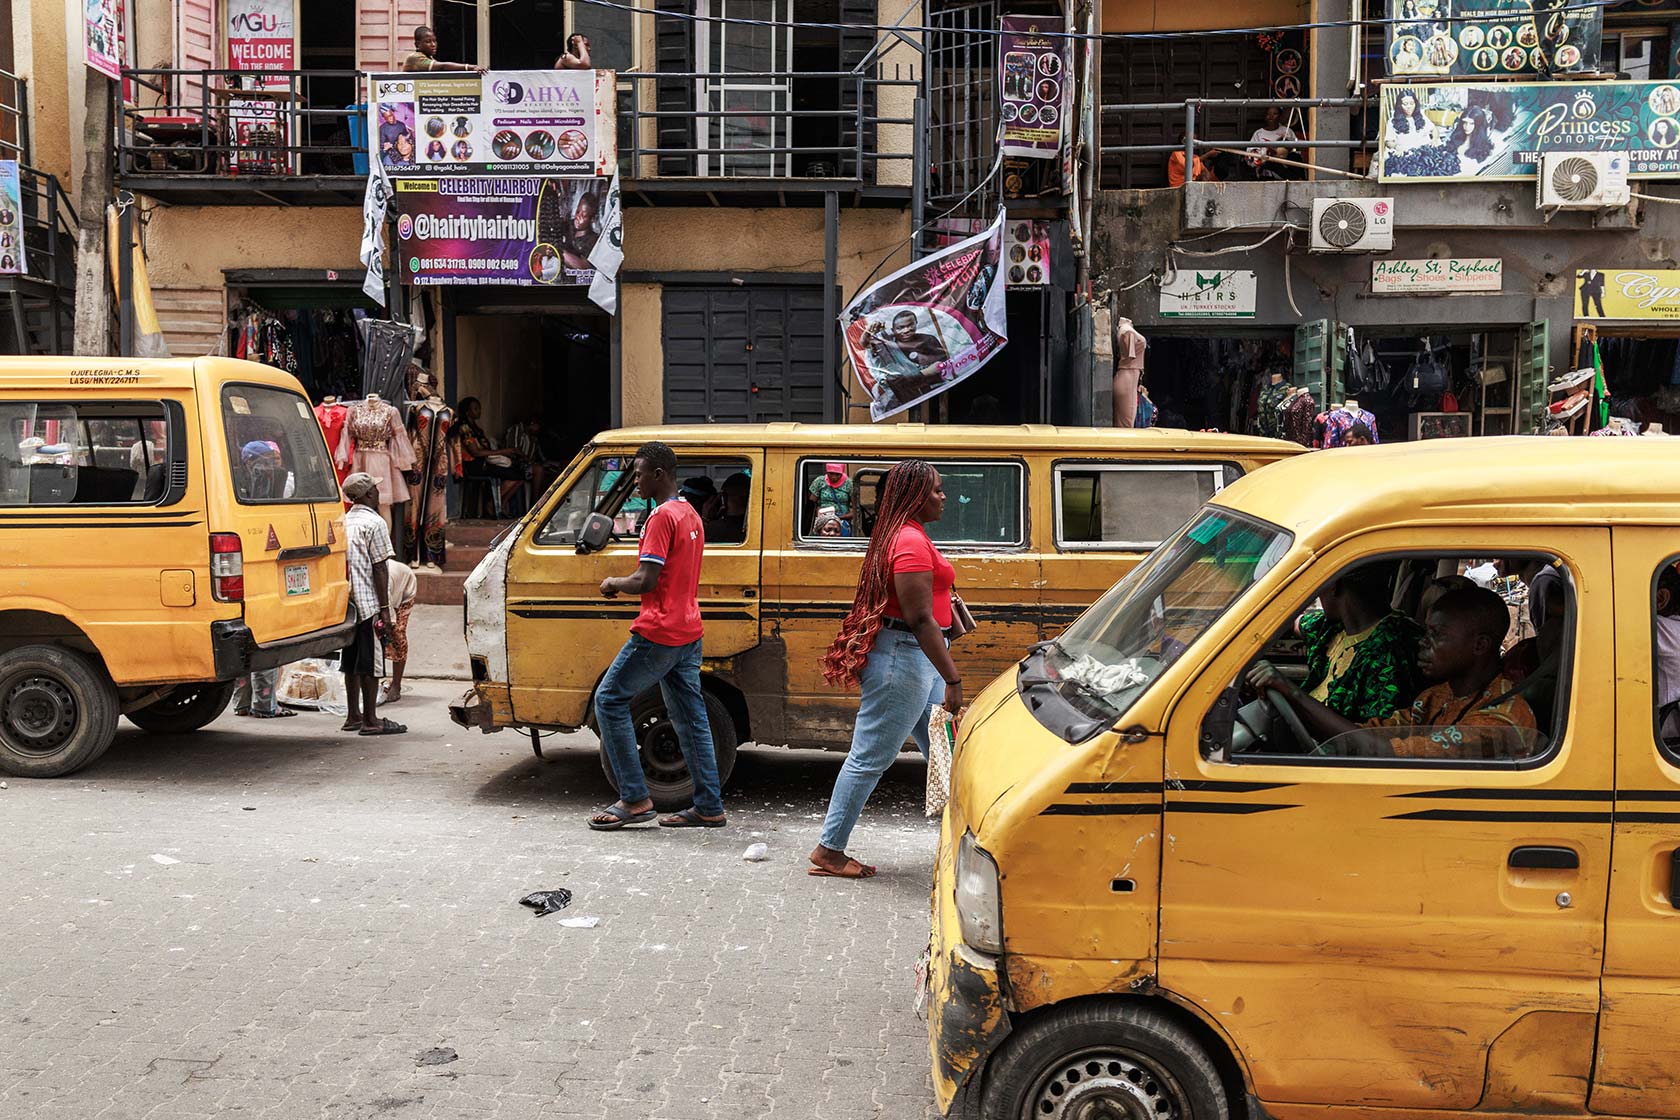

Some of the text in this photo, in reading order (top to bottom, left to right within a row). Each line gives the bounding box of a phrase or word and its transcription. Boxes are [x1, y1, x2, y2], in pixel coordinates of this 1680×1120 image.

[231, 44, 291, 59] WELCOME
[240, 63, 284, 71] TO THE HOME
[506, 82, 580, 104] DAHYA
[1527, 103, 1631, 150] Princess
[1543, 135, 1595, 144] DONOR
[1519, 152, 1538, 163] THE
[1666, 150, 1679, 160] AT
[403, 178, 540, 196] Welcome to CELEBRITY HAIRBOY
[414, 213, 536, 242] @hairbyhairboy
[421, 258, 433, 270] 081
[468, 258, 486, 270] 0909
[501, 258, 518, 270] 6409
[1376, 261, 1419, 280] Ashley
[1449, 259, 1500, 276] Raphael
[1378, 272, 1494, 284] Bags Shoes Slippers
[1182, 292, 1236, 301] HEIRS
